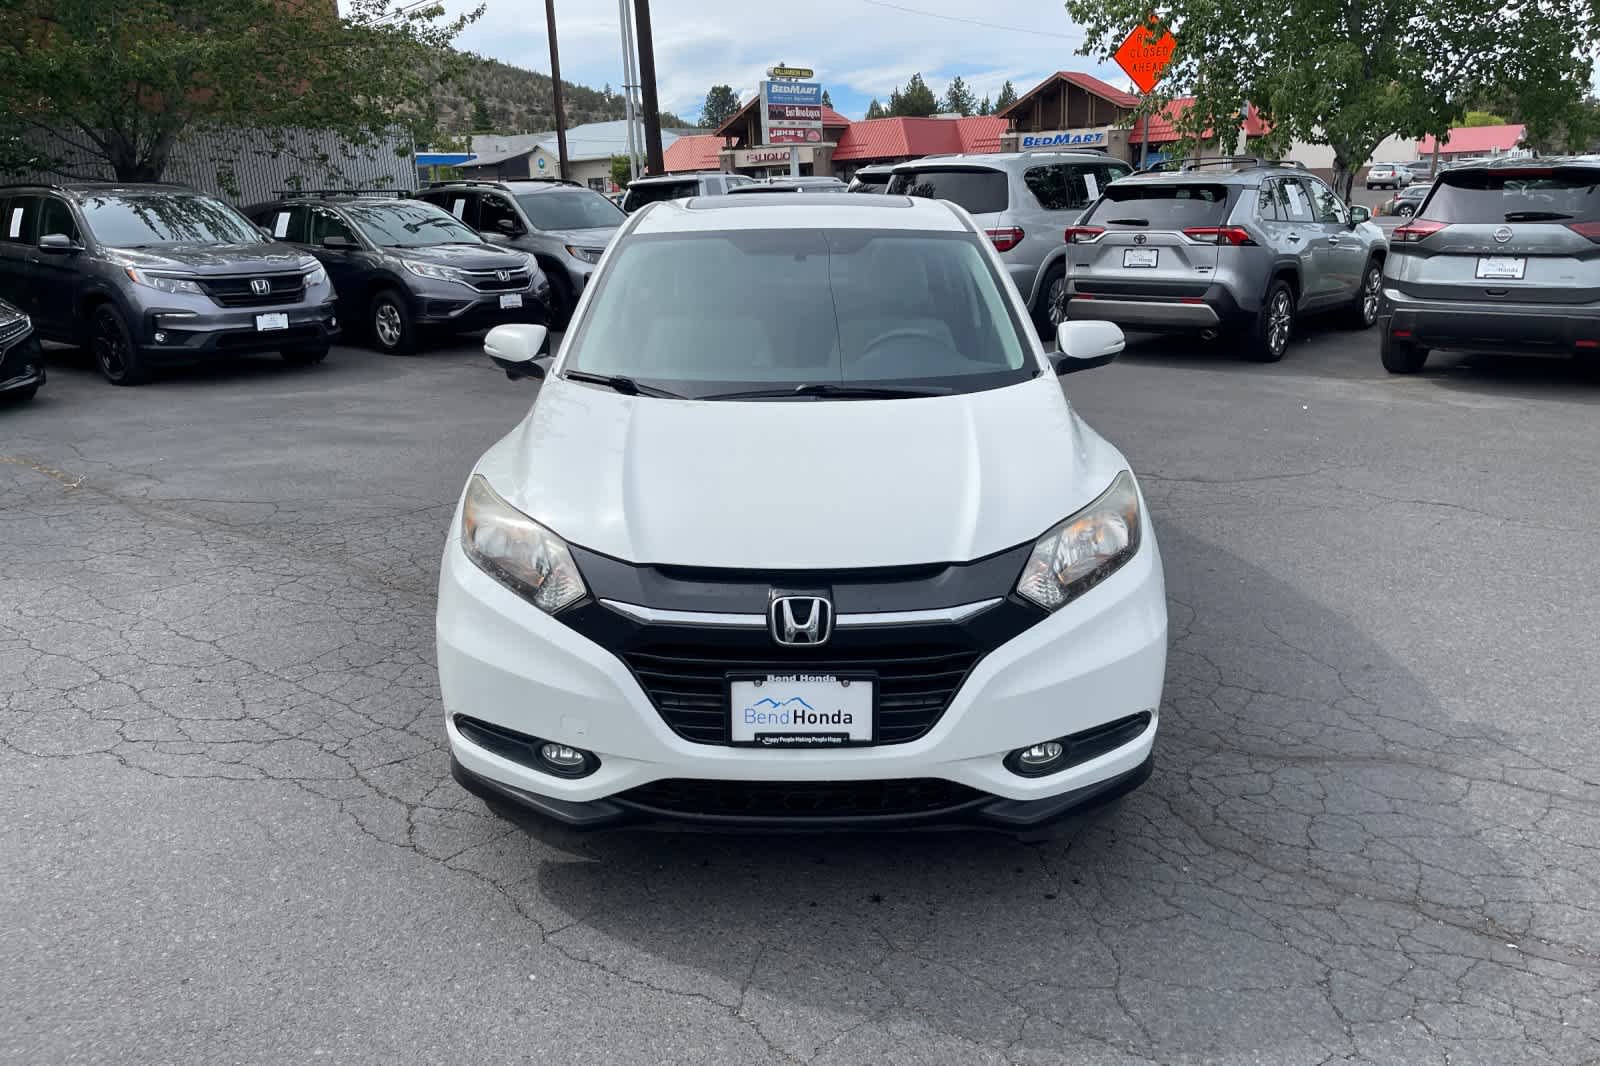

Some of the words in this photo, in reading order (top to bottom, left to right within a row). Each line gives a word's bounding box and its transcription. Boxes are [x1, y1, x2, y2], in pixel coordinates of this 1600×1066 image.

[1130, 47, 1169, 58] CLOSED
[759, 152, 790, 162] LIQUO
[767, 674, 796, 682] Bend
[800, 674, 837, 682] Honda
[744, 708, 789, 724] Bend
[793, 709, 853, 725] Honda
